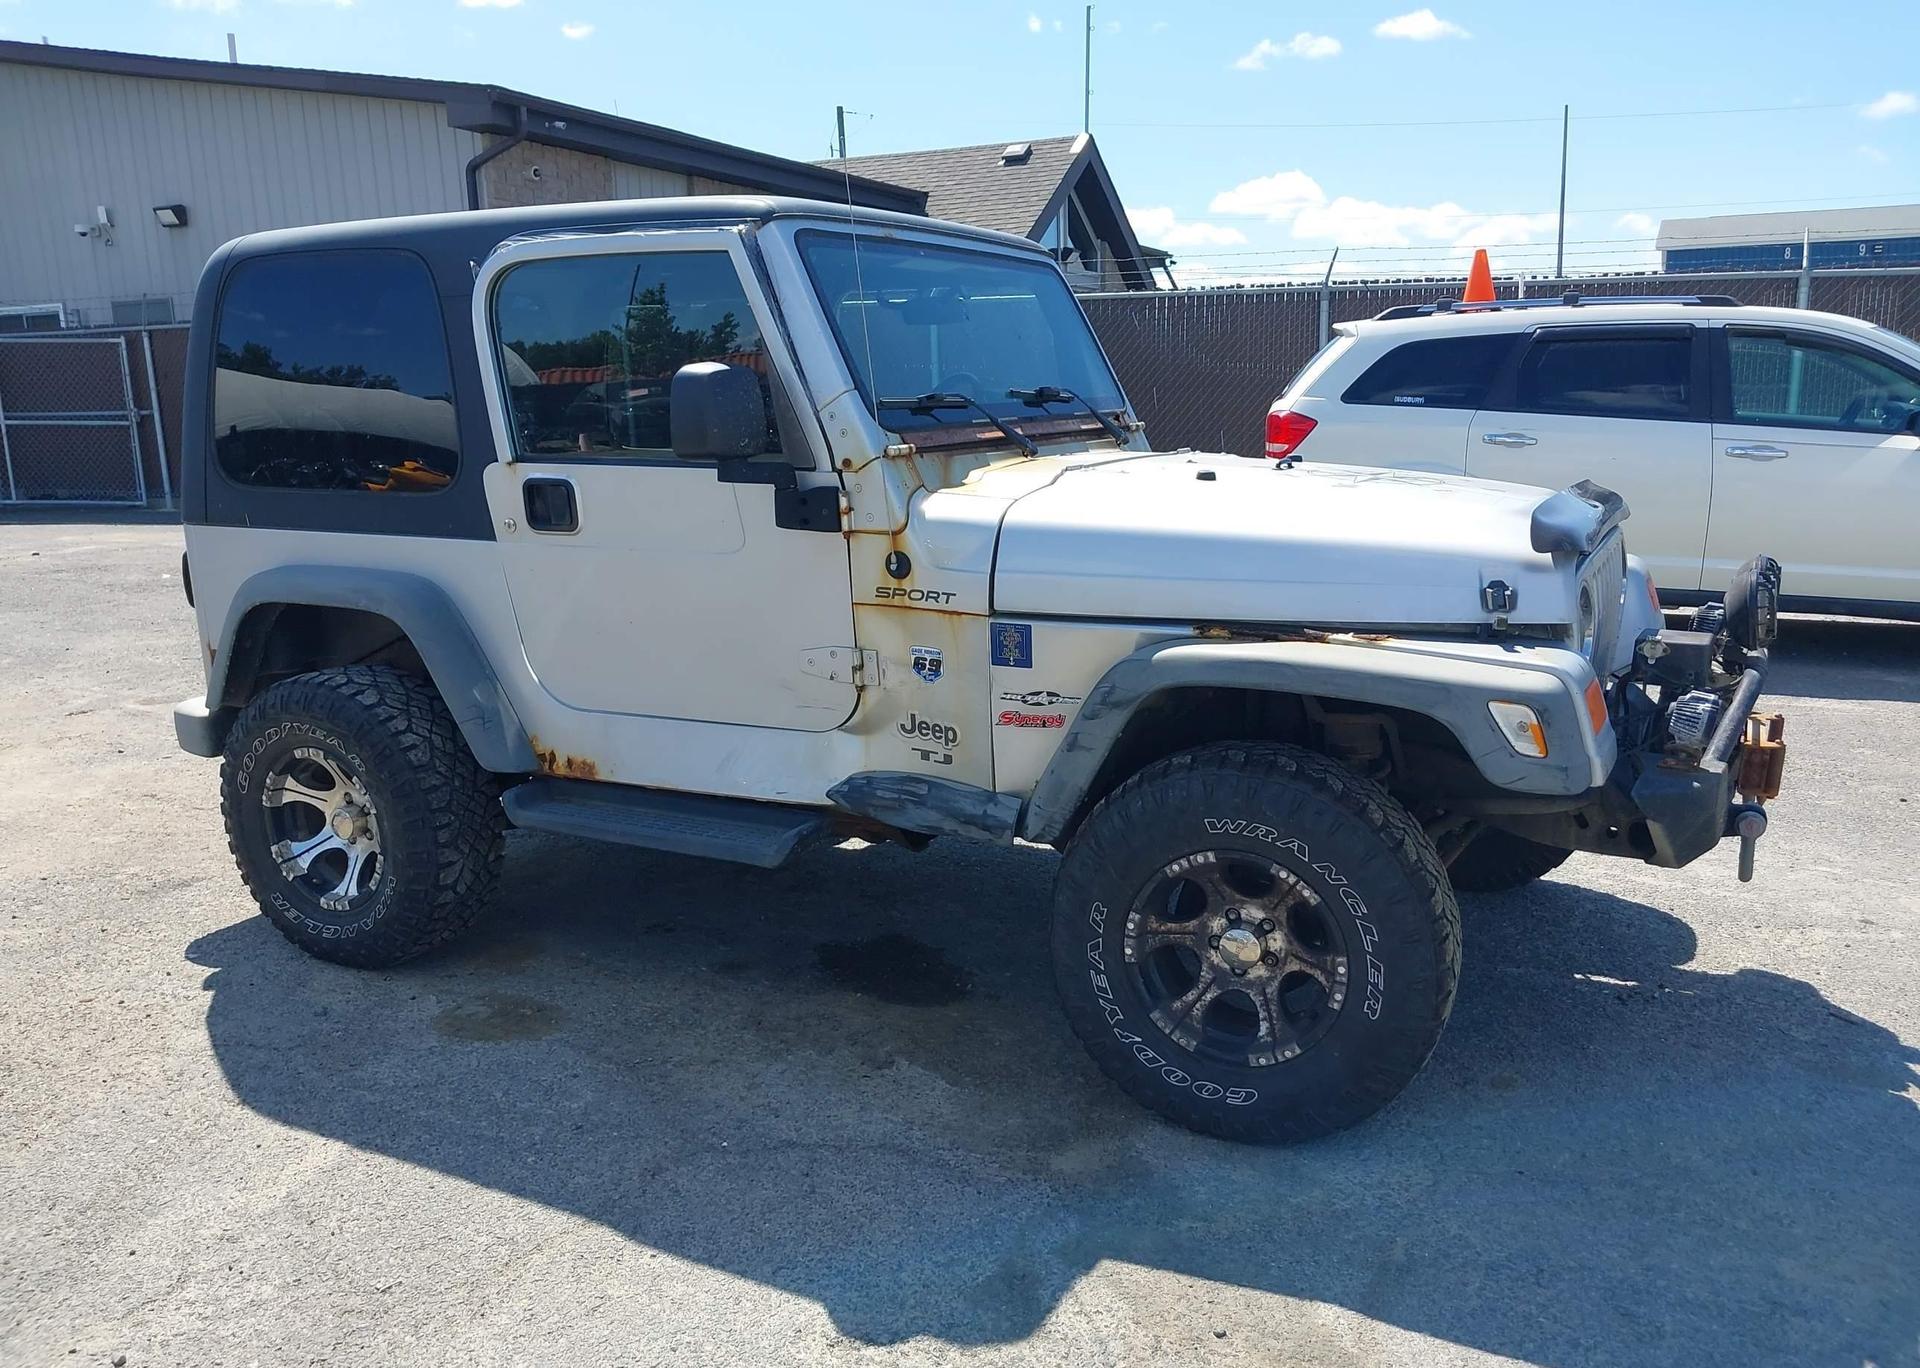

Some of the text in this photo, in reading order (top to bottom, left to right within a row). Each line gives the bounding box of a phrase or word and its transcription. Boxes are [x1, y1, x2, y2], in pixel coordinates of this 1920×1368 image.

[1784, 247, 1791, 260] 8
[1859, 243, 1866, 257] 9
[874, 586, 957, 605] SPORT
[912, 656, 942, 671] 69
[900, 713, 958, 747] Jeep
[237, 722, 366, 794] GOODYEAR
[911, 747, 953, 765] TJ
[270, 876, 398, 939] WRANGLER
[1203, 817, 1385, 1021] WRANGLER
[1086, 901, 1259, 1106] GOODYEAR
